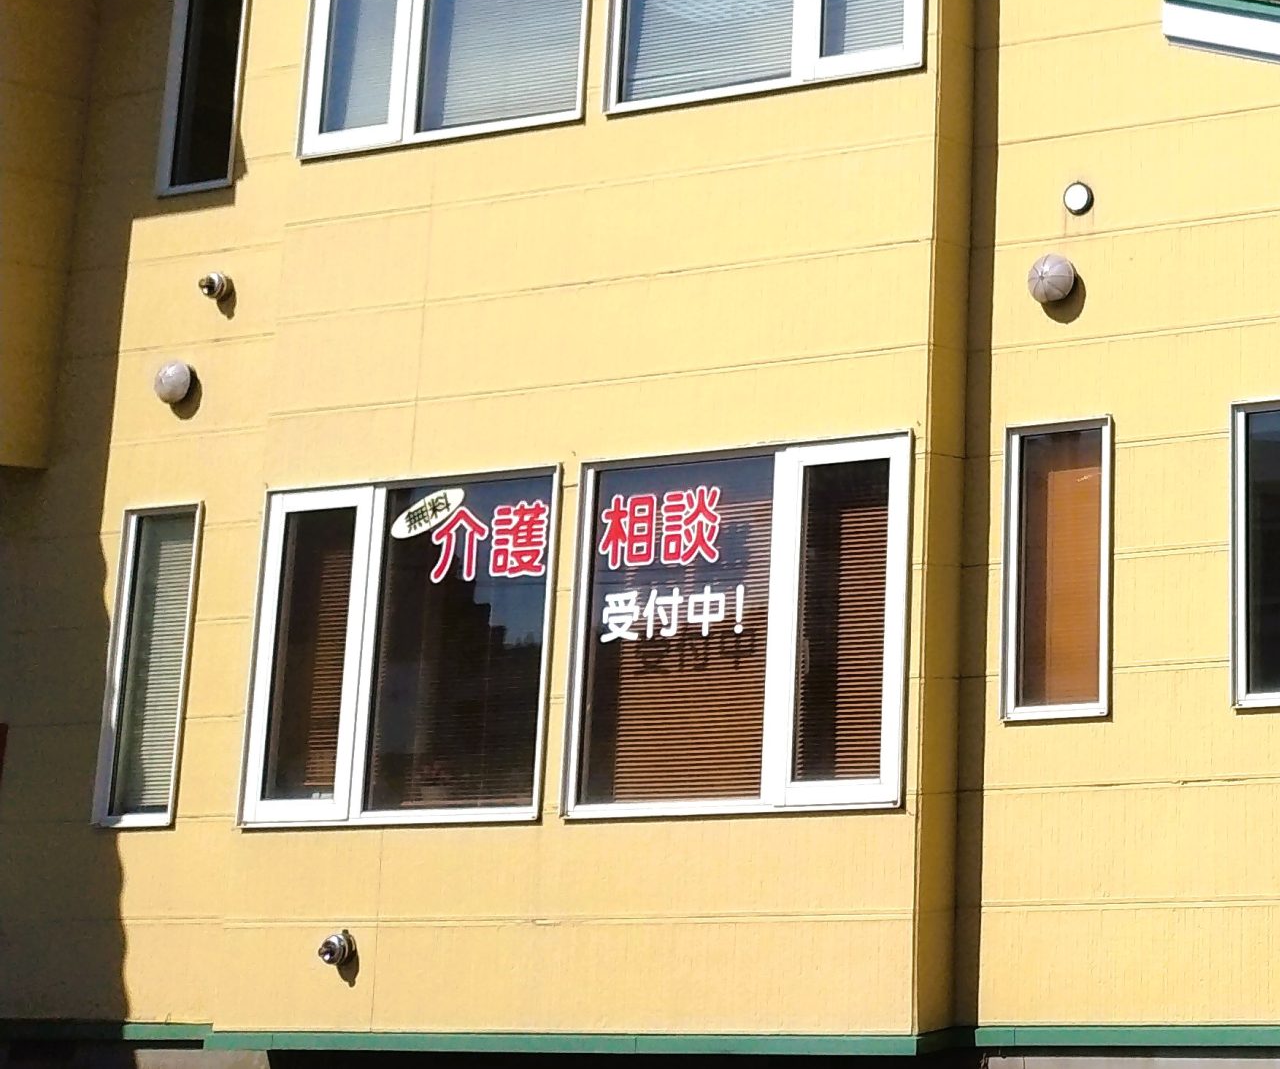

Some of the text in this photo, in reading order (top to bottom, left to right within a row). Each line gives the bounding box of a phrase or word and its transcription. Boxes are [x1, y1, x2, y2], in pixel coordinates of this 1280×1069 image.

[405, 491, 450, 533] 無料
[430, 486, 721, 583] 介護 相談
[600, 584, 745, 644] 受付中!
